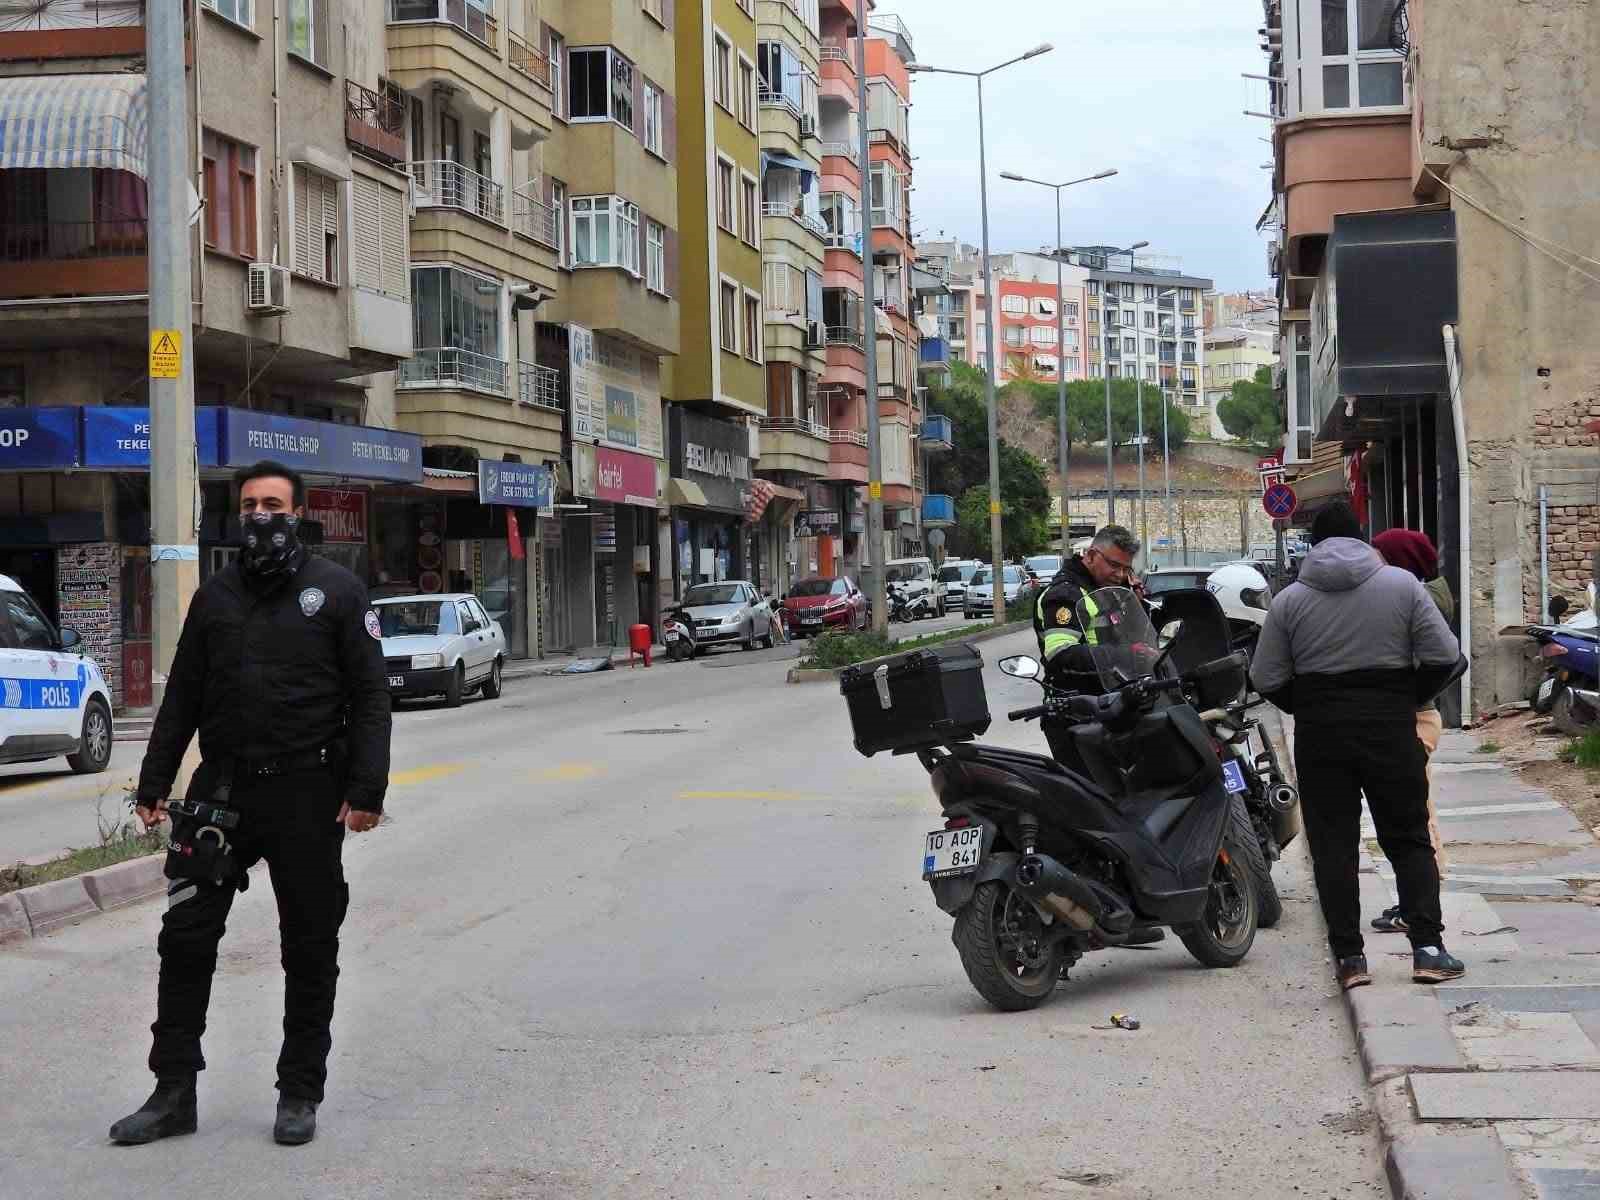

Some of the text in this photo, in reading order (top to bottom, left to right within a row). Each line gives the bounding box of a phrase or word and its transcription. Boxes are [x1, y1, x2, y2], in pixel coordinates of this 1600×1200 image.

[248, 430, 320, 455] PETEK TEKEL SHOP
[41, 682, 71, 706] POLİS
[930, 829, 979, 851] 10 AOP
[952, 848, 977, 866] 841
